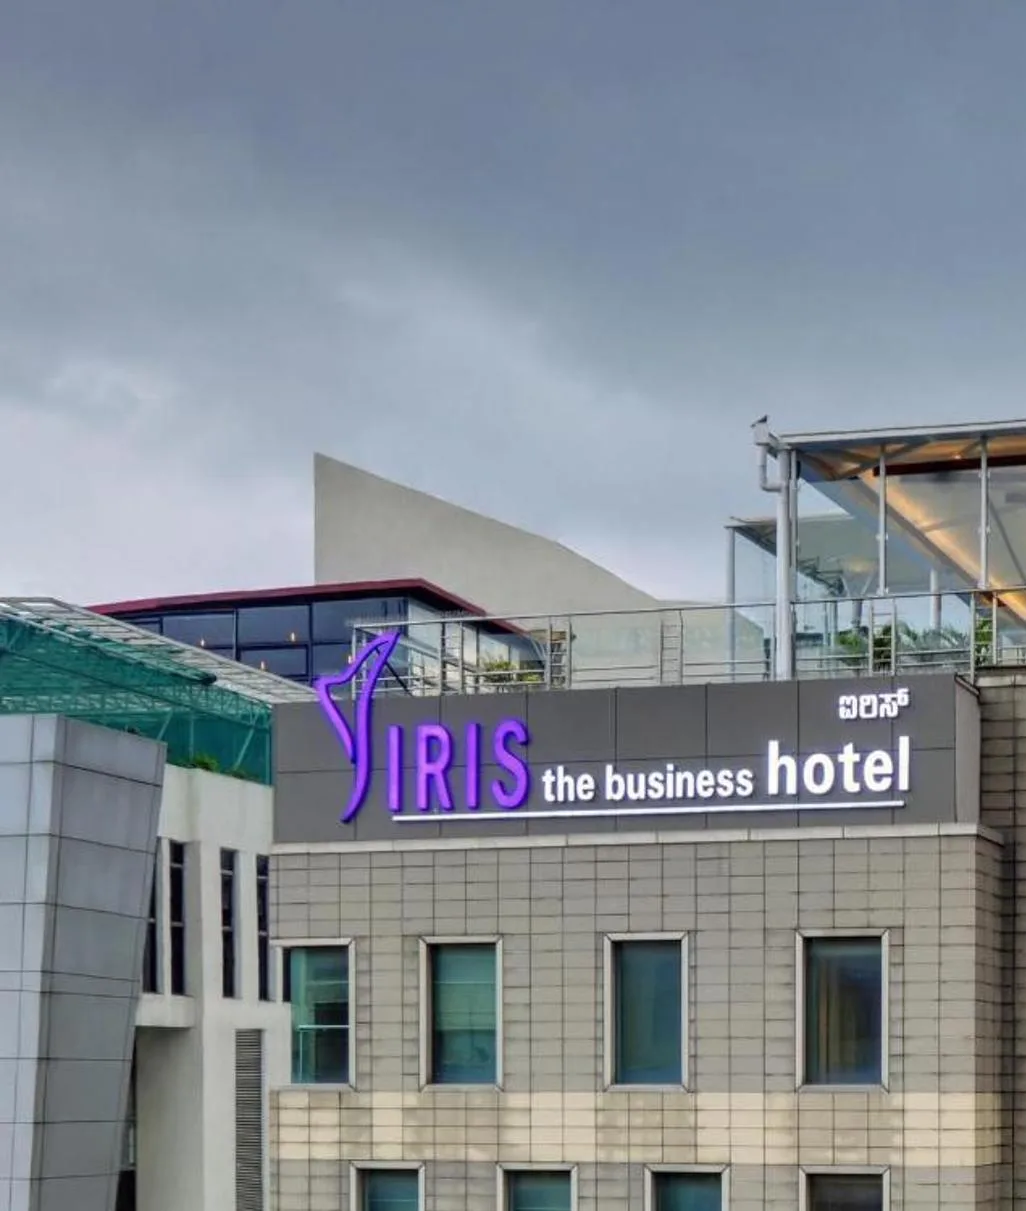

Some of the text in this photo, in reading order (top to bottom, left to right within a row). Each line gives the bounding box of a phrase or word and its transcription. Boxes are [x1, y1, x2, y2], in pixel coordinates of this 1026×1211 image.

[838, 687, 910, 720] ಐರಿಸ್
[387, 718, 910, 813] IRIS the business hotel
